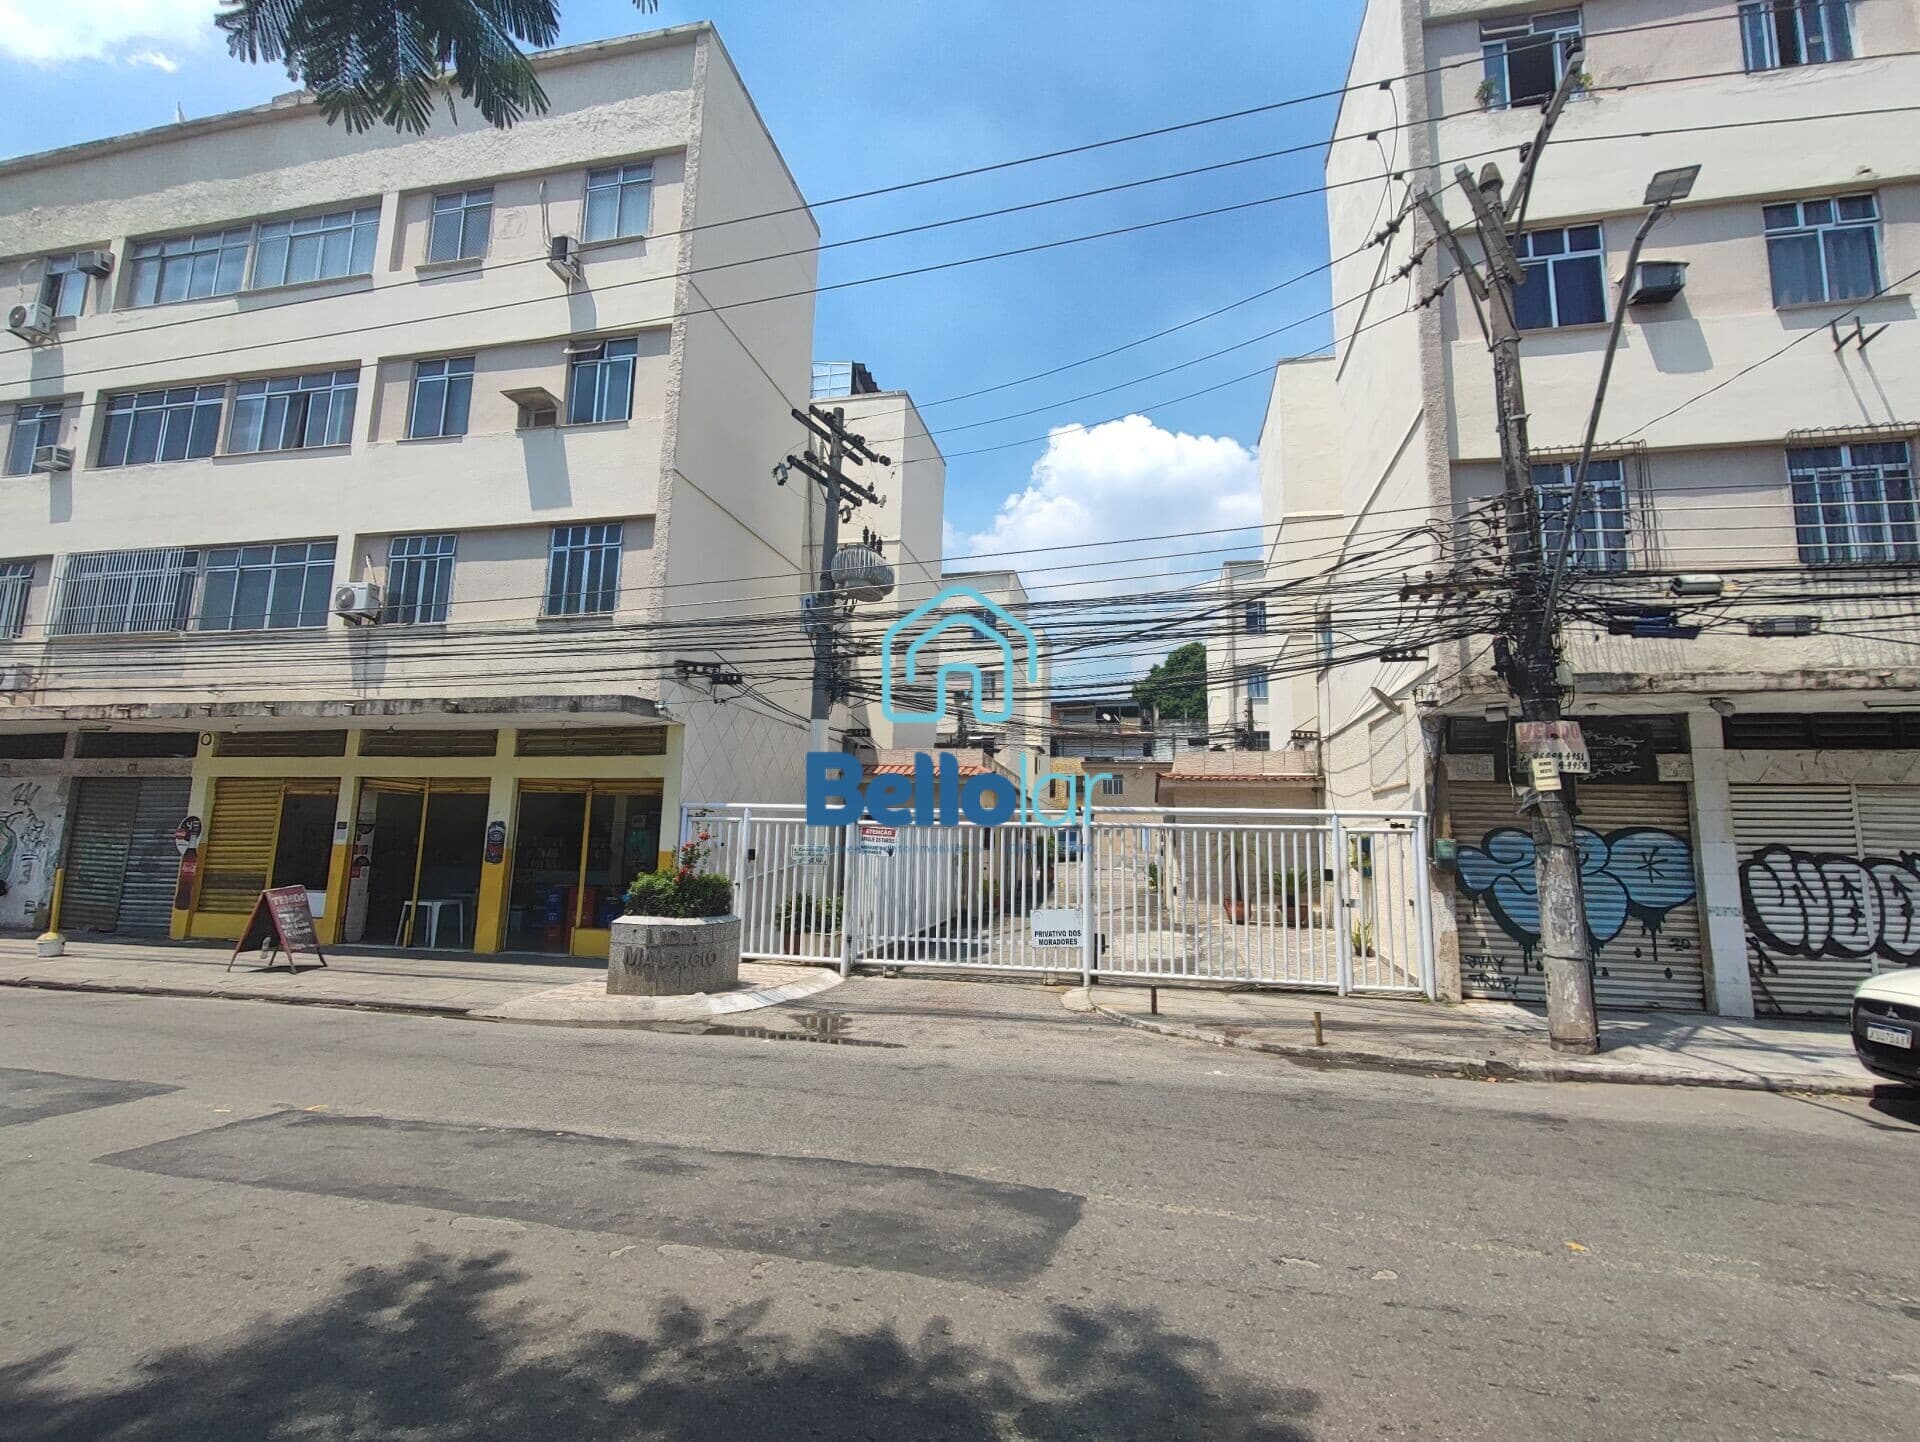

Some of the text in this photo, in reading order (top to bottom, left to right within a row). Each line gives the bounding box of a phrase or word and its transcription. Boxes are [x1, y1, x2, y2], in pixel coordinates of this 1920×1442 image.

[1034, 929, 1082, 938] PRIVATIVO DOS
[1038, 938, 1078, 946] MORADORES
